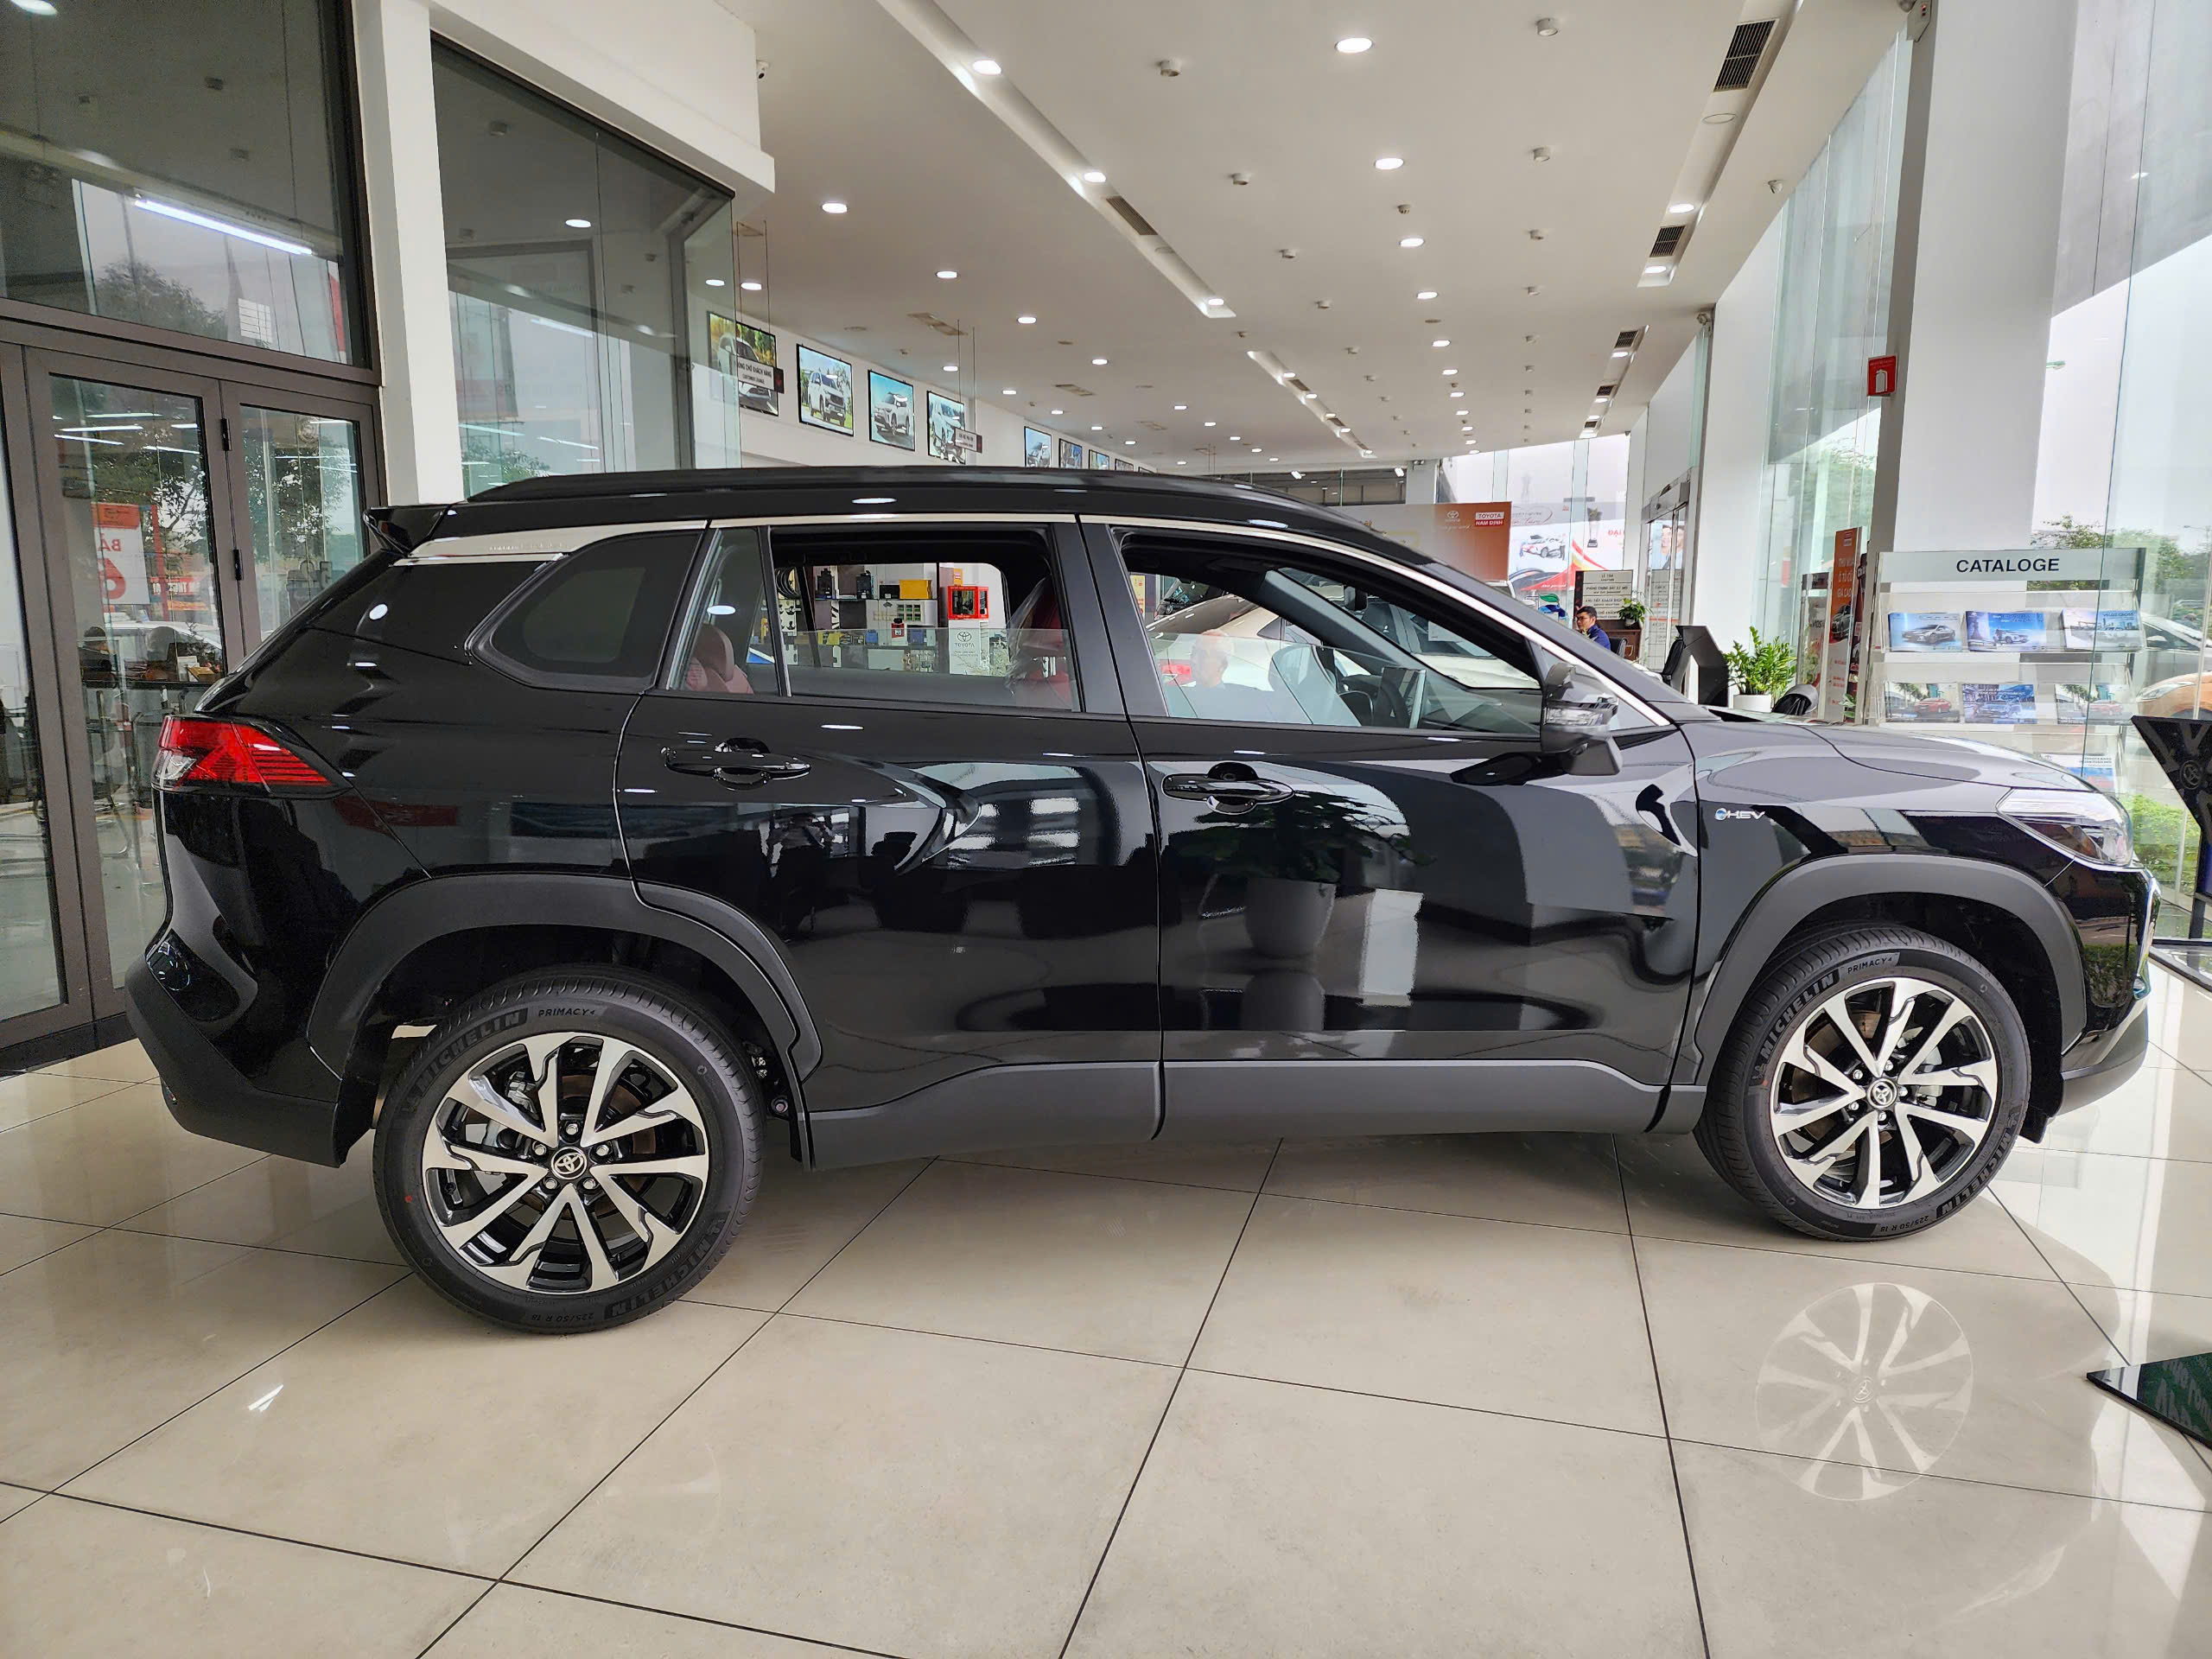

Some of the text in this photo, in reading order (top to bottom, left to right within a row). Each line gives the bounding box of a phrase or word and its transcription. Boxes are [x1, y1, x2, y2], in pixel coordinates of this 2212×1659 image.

[1955, 558, 2060, 573] CATALOGE
[418, 1011, 521, 1093] MICHELIN
[1759, 971, 1834, 1060] MICHELIN
[1942, 1132, 2012, 1216] MICHELIN
[1898, 1215, 1929, 1230] 225/50
[610, 1235, 713, 1318] MICHELIN
[556, 1313, 594, 1323] 225/50
